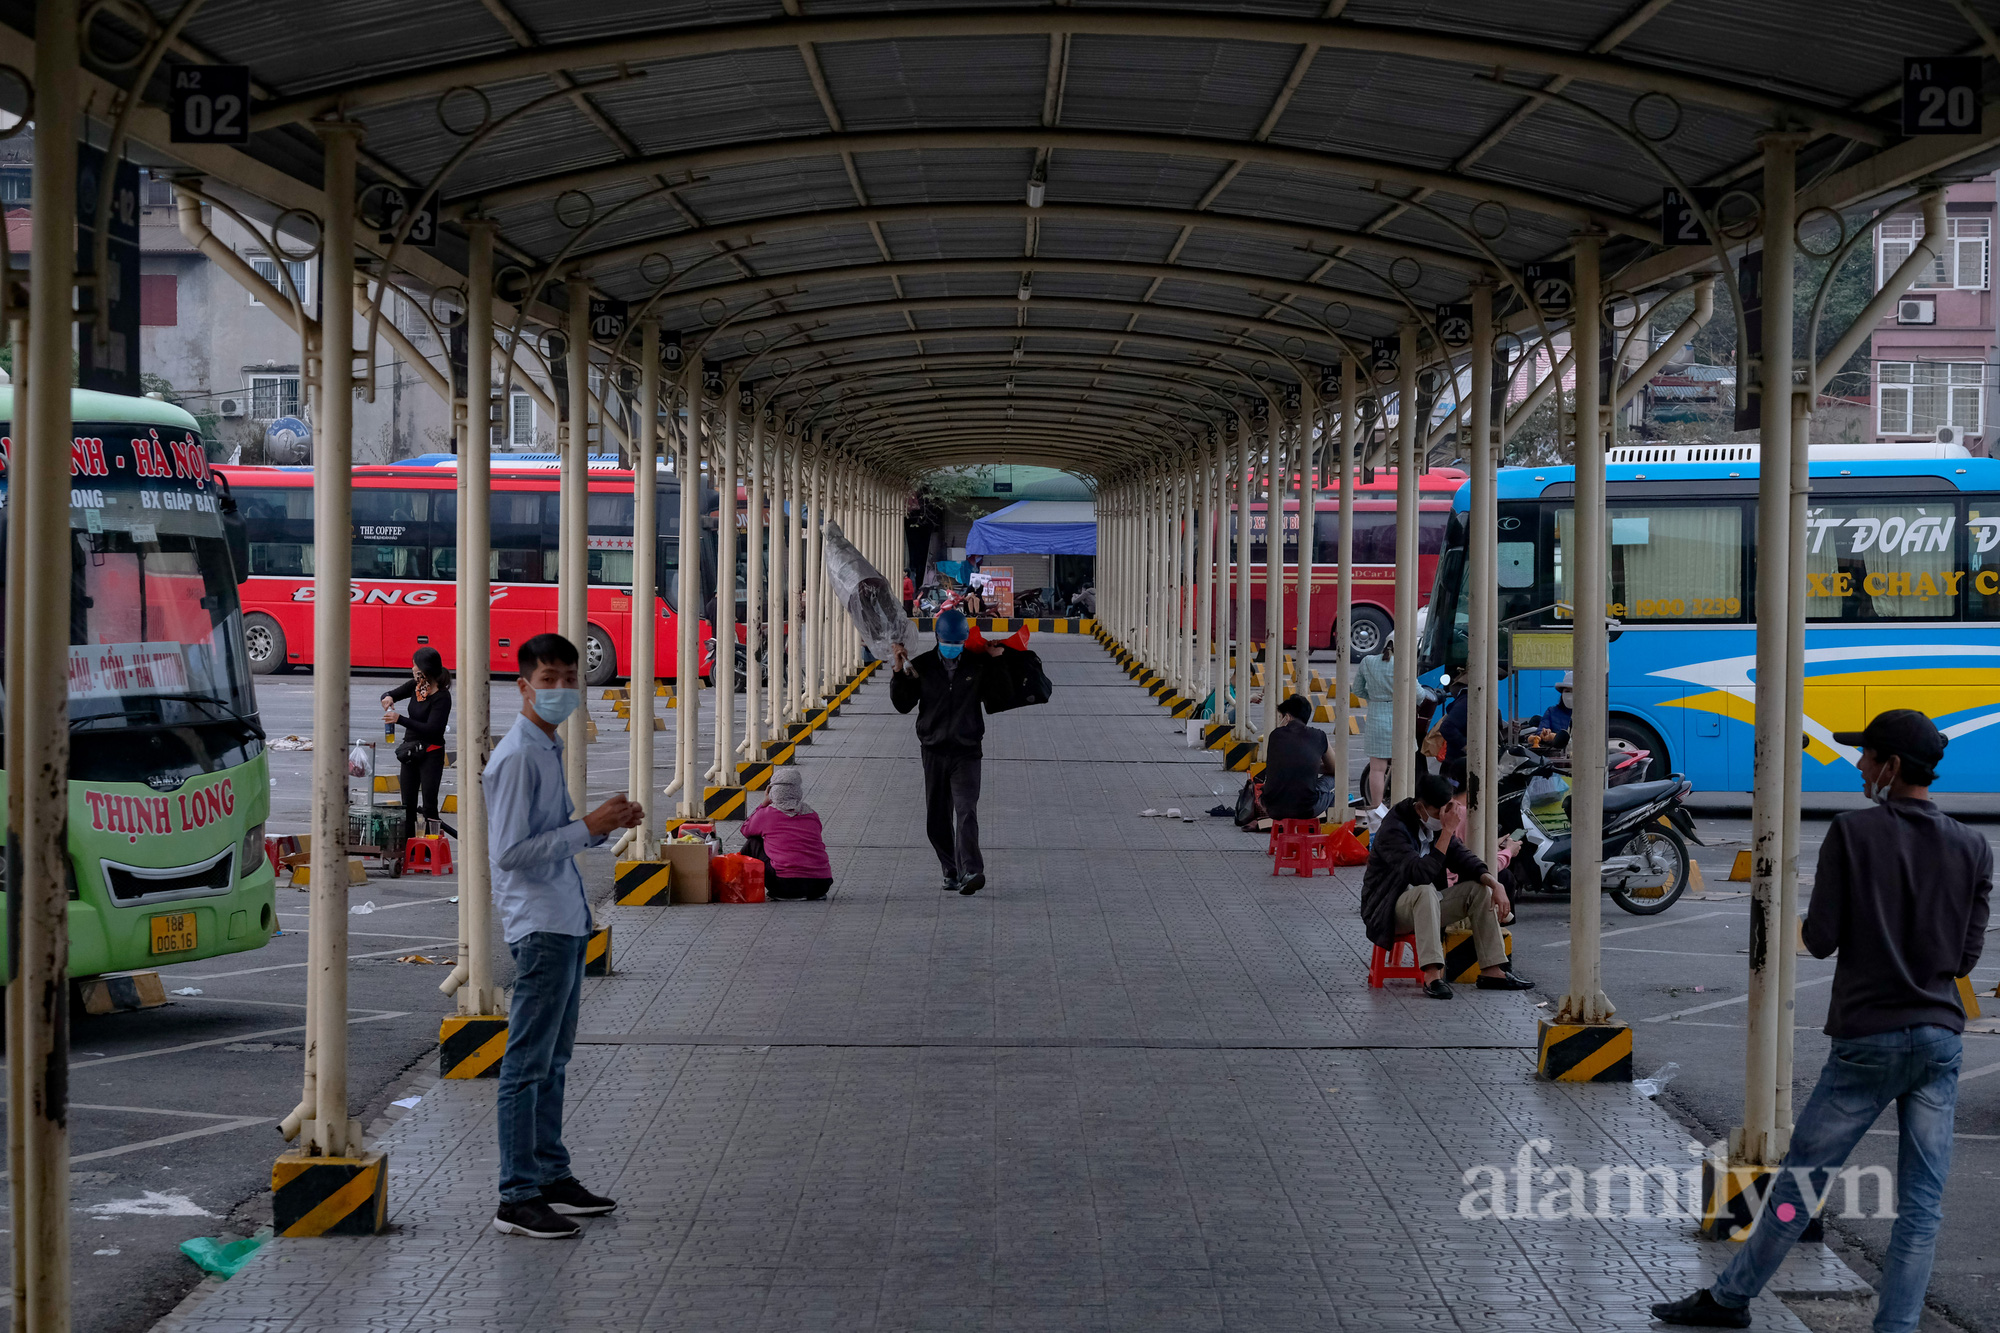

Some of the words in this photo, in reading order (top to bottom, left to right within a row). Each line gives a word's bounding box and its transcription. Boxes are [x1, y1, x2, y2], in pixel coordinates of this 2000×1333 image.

[176, 71, 201, 88] A2
[1909, 63, 1932, 81] A1
[184, 94, 243, 136] 02
[1918, 86, 1975, 127] 20
[1527, 265, 1540, 277] A1
[1533, 279, 1567, 304] 22
[592, 303, 606, 312] A2
[1438, 306, 1450, 316] A1
[597, 315, 624, 336] 05
[1443, 319, 1471, 339] 23
[1374, 339, 1384, 348] A1
[131, 427, 173, 479] HÀ
[170, 432, 212, 491] NỘI
[70, 489, 105, 509] ONG
[140, 490, 162, 510] BX
[163, 487, 193, 512] GIÁP
[195, 490, 217, 514] BÁT
[360, 526, 374, 535] THE
[1843, 507, 1957, 556] ĐOÀN
[1807, 571, 1853, 598] XE
[1863, 570, 1966, 602] CHẠY
[1636, 598, 1685, 617] 1900
[1691, 597, 1741, 616] 3239
[85, 789, 172, 845] THỊNH
[178, 776, 235, 833] LONG
[166, 915, 184, 932] 18B
[157, 932, 193, 952] 006.16
